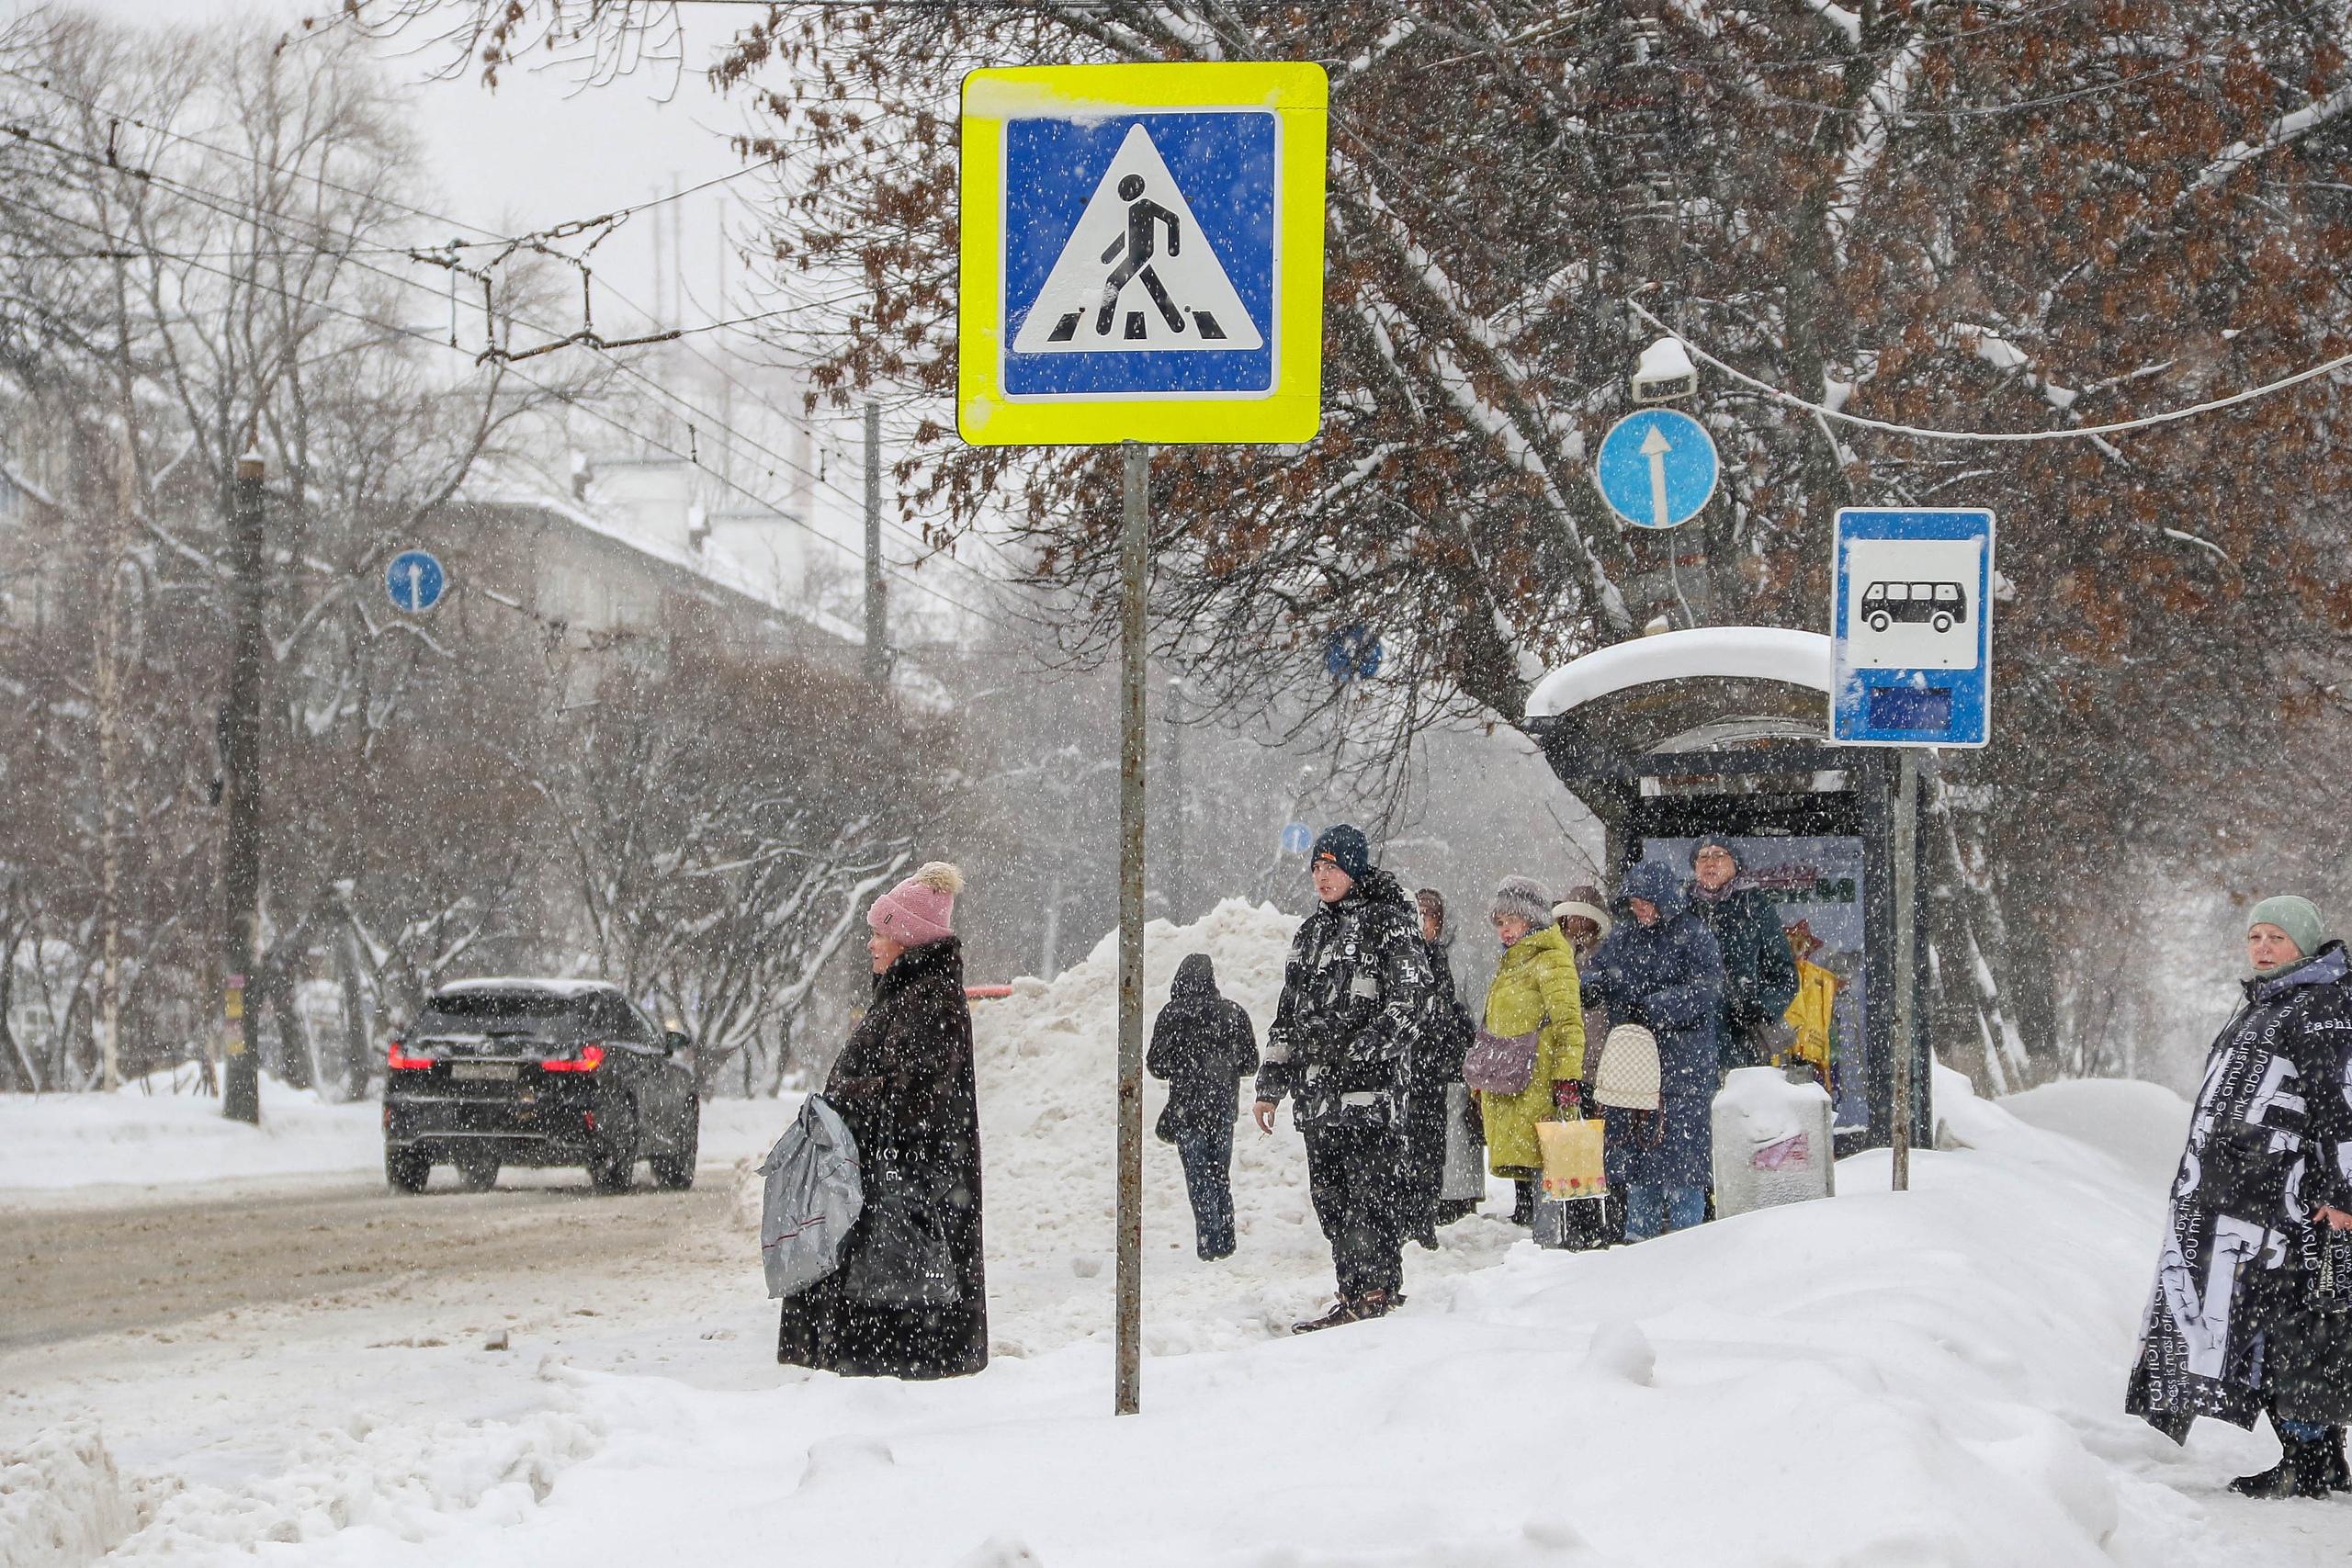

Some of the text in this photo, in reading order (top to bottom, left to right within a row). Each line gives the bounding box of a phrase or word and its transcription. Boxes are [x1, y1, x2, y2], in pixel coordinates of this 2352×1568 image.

[2222, 1031, 2257, 1097] amusing
[2244, 1047, 2270, 1094] about
[2261, 1020, 2280, 1046] you
[2278, 1005, 2294, 1019] at
[2185, 1238, 2199, 1269] you
[2335, 1264, 2347, 1294] you
